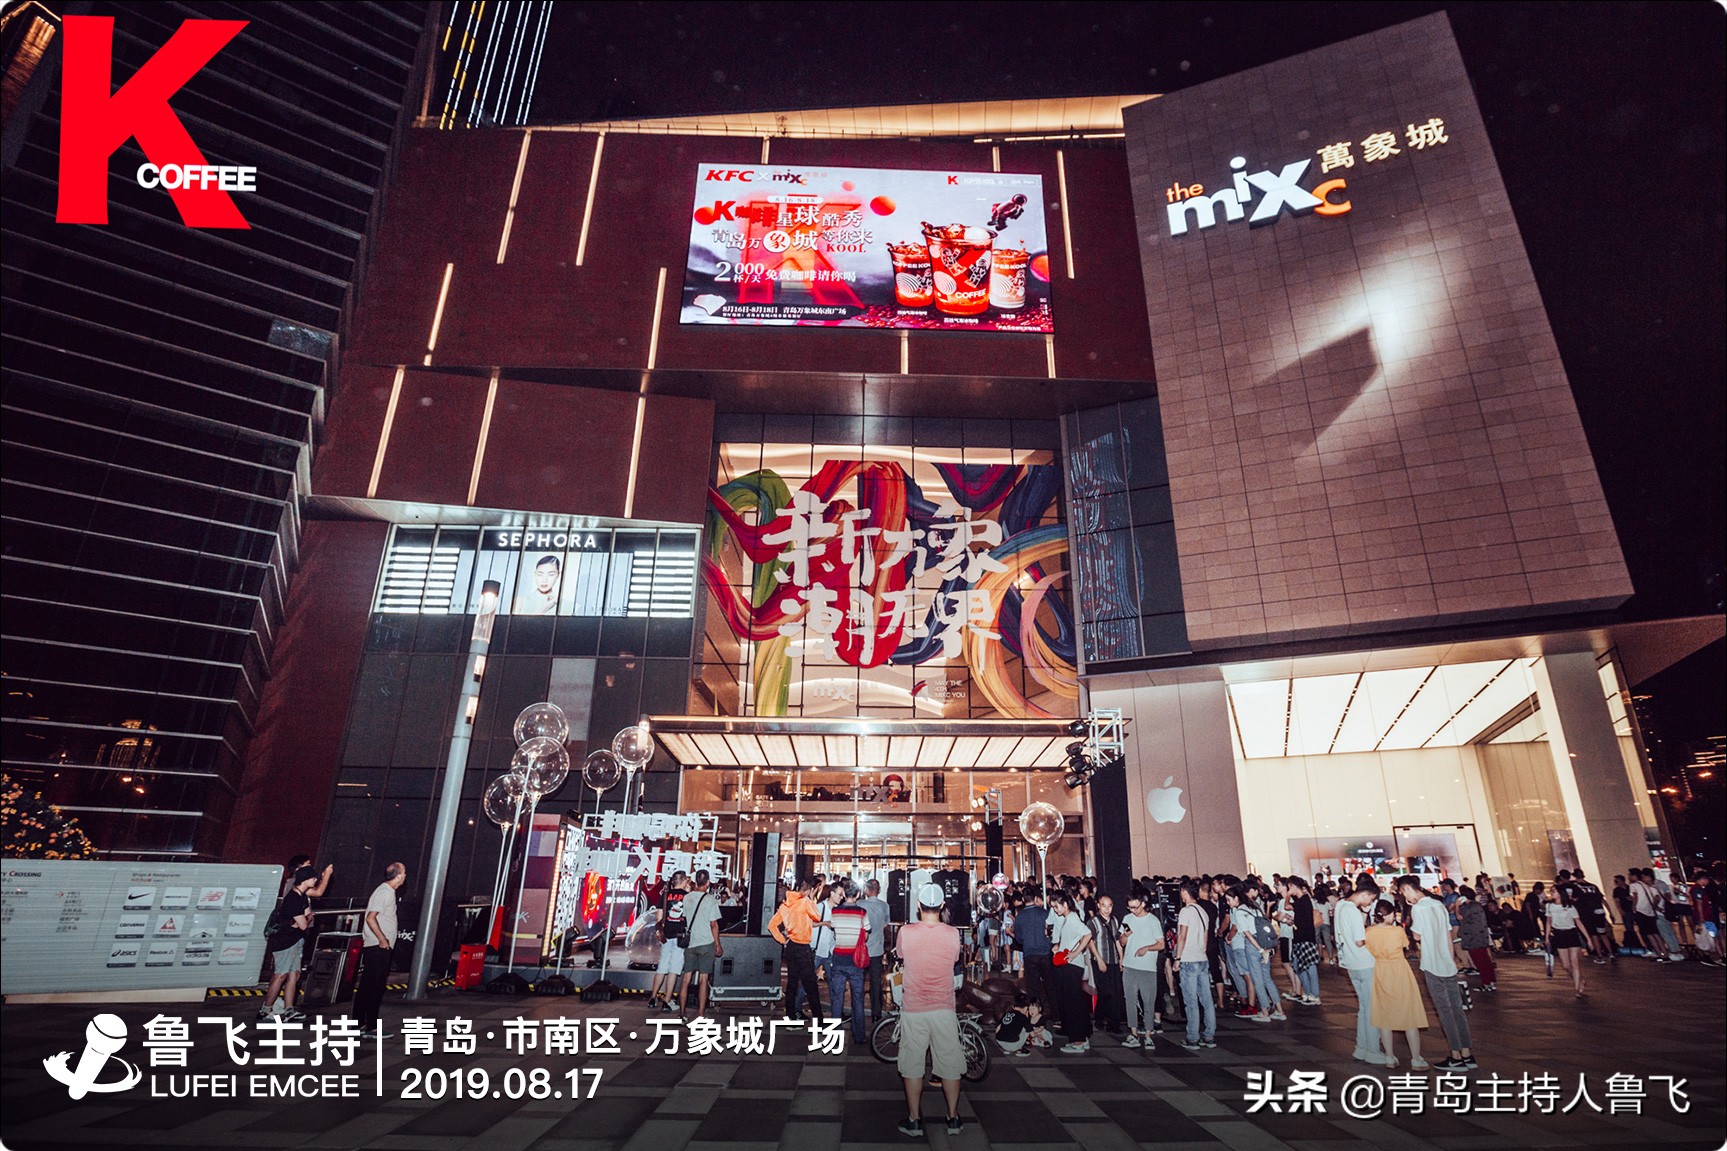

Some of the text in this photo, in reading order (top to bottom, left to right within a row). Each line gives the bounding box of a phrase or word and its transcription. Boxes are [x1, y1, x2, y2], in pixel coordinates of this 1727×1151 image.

[1316, 118, 1450, 173] 萬象城
[705, 169, 754, 182] KFC
[947, 175, 958, 185] K
[1166, 182, 1204, 203] the
[826, 243, 867, 253] KOOL
[765, 269, 857, 283] 免费咖啡请你喝
[955, 288, 986, 299] COFFEE
[498, 532, 596, 549] SEPHORA
